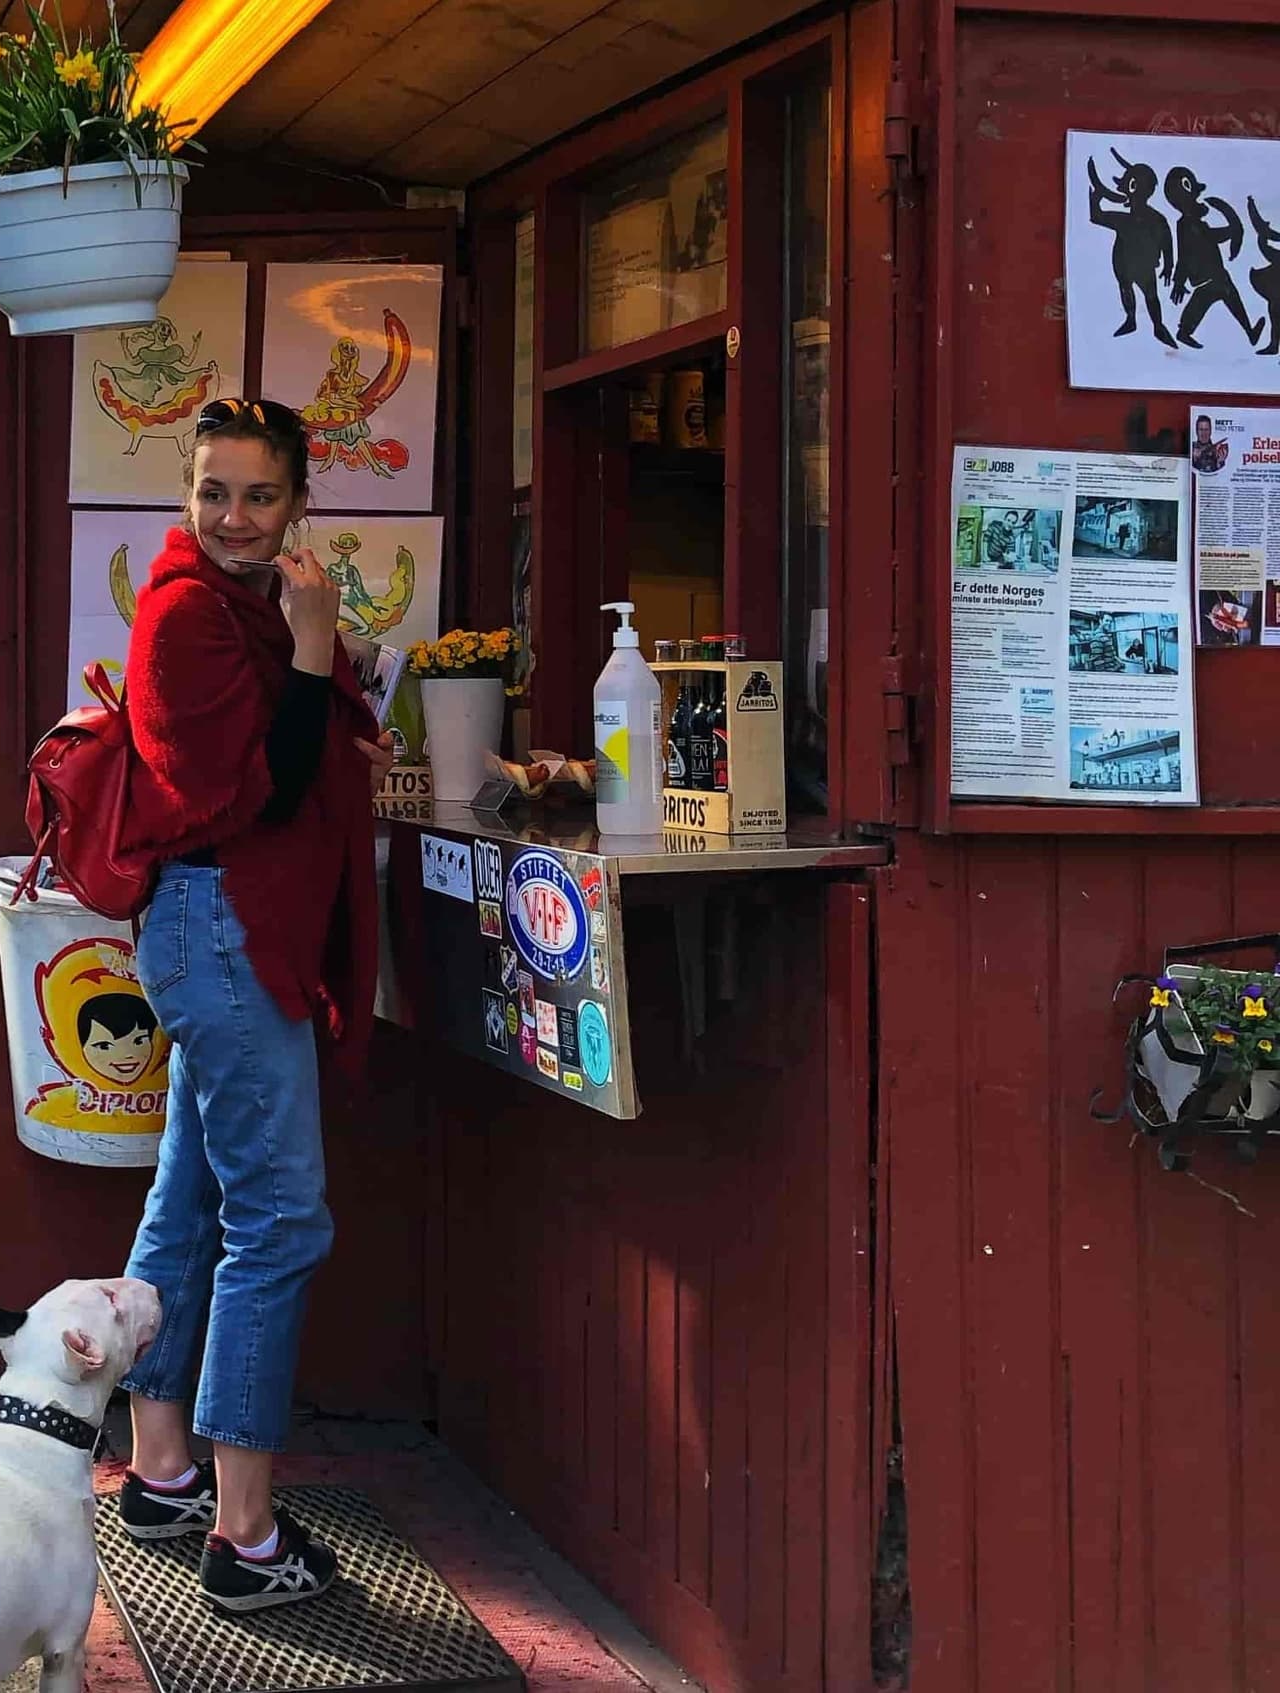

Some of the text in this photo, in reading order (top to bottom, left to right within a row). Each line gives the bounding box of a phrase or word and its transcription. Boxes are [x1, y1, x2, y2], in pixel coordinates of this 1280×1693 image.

[988, 461, 1015, 473] JOBB
[953, 582, 1045, 598] Er dette Norges
[952, 595, 1043, 607] minste arbeidsplass?
[520, 859, 567, 890] STIFTET
